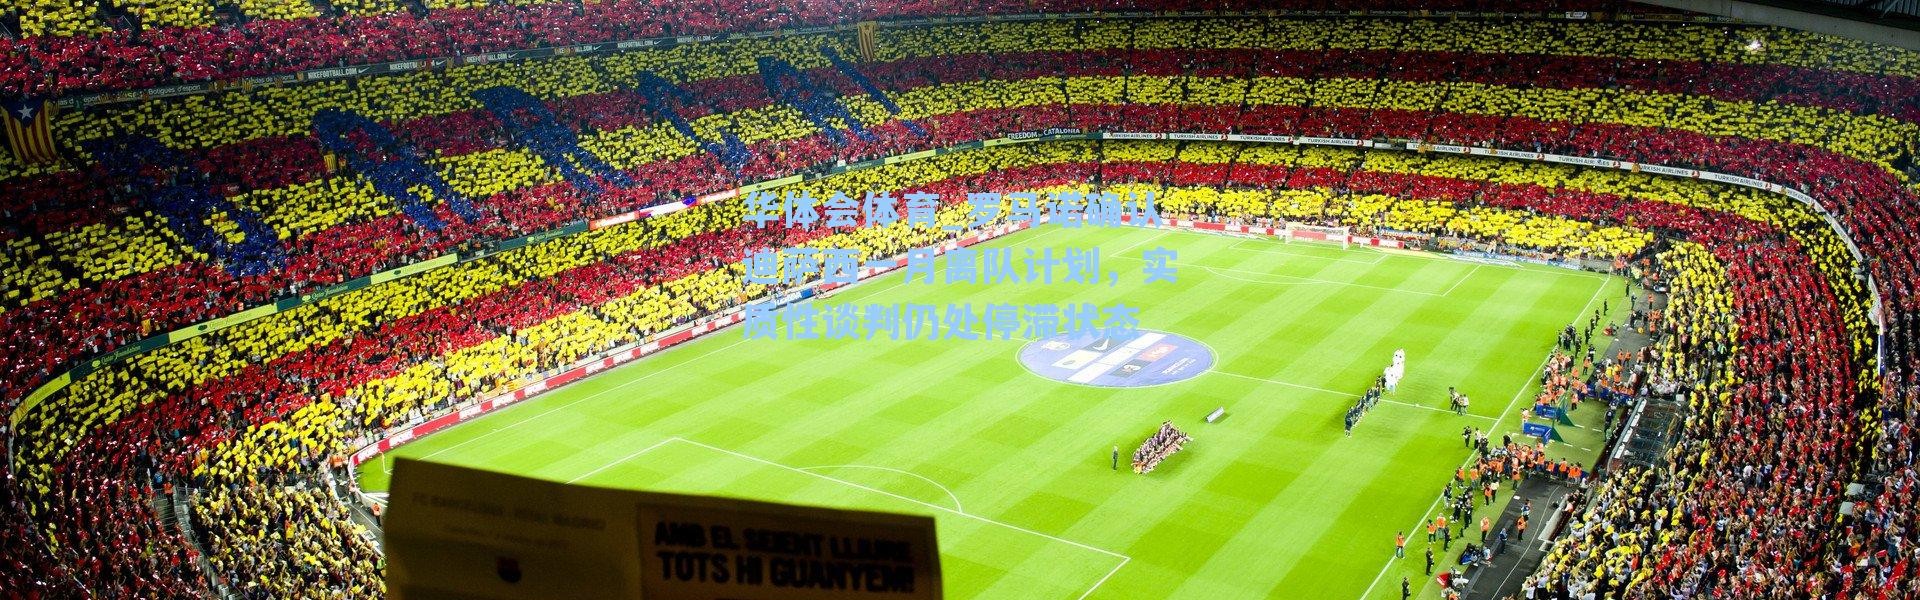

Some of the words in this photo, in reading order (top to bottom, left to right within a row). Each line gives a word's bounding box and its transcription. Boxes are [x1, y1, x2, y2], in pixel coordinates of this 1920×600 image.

[307, 67, 357, 79] NIKEFOOTBALL.COM
[1007, 131, 1038, 141] FREEDOM
[1043, 127, 1081, 136] CATALONIA
[1558, 156, 1583, 164] TURKISH
[1661, 167, 1689, 176] AIRLINES
[1714, 174, 1740, 183] TURKISH
[1739, 178, 1763, 188] AIRLINES
[711, 525, 738, 549] EL
[657, 551, 730, 583] TOTS
[736, 555, 762, 585] HI
